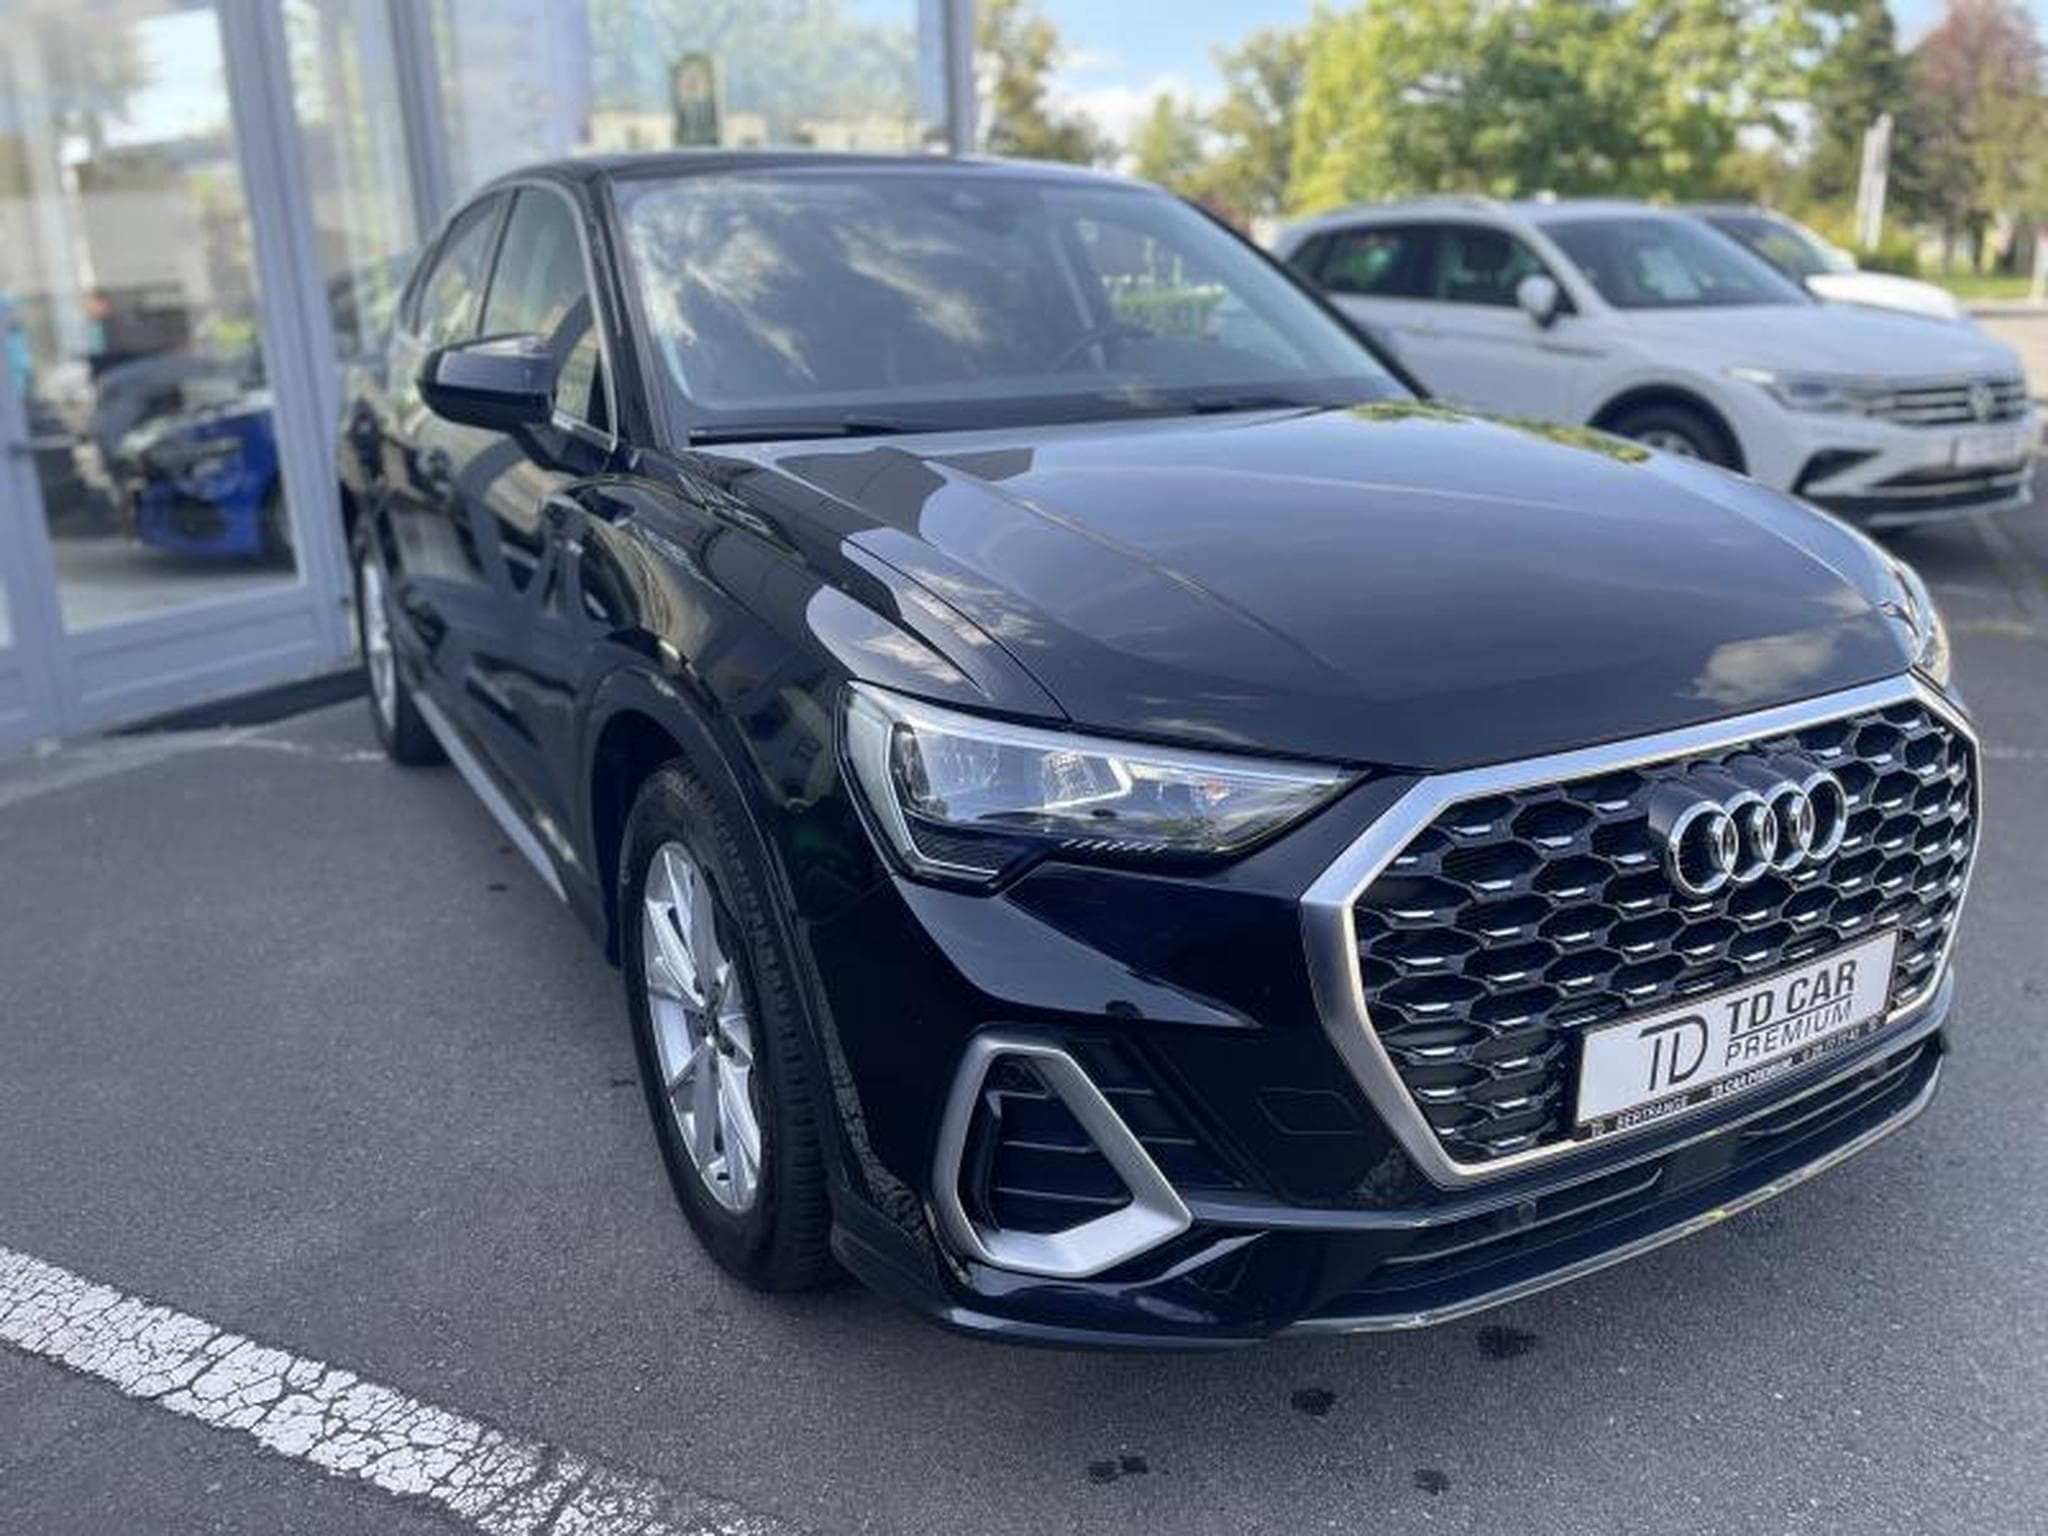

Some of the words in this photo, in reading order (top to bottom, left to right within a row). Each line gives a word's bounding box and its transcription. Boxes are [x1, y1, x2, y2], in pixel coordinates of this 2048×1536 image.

[1726, 990, 1775, 1035] TD
[1786, 959, 1857, 1014] CAR
[1723, 1001, 1853, 1067] PREMIUM
